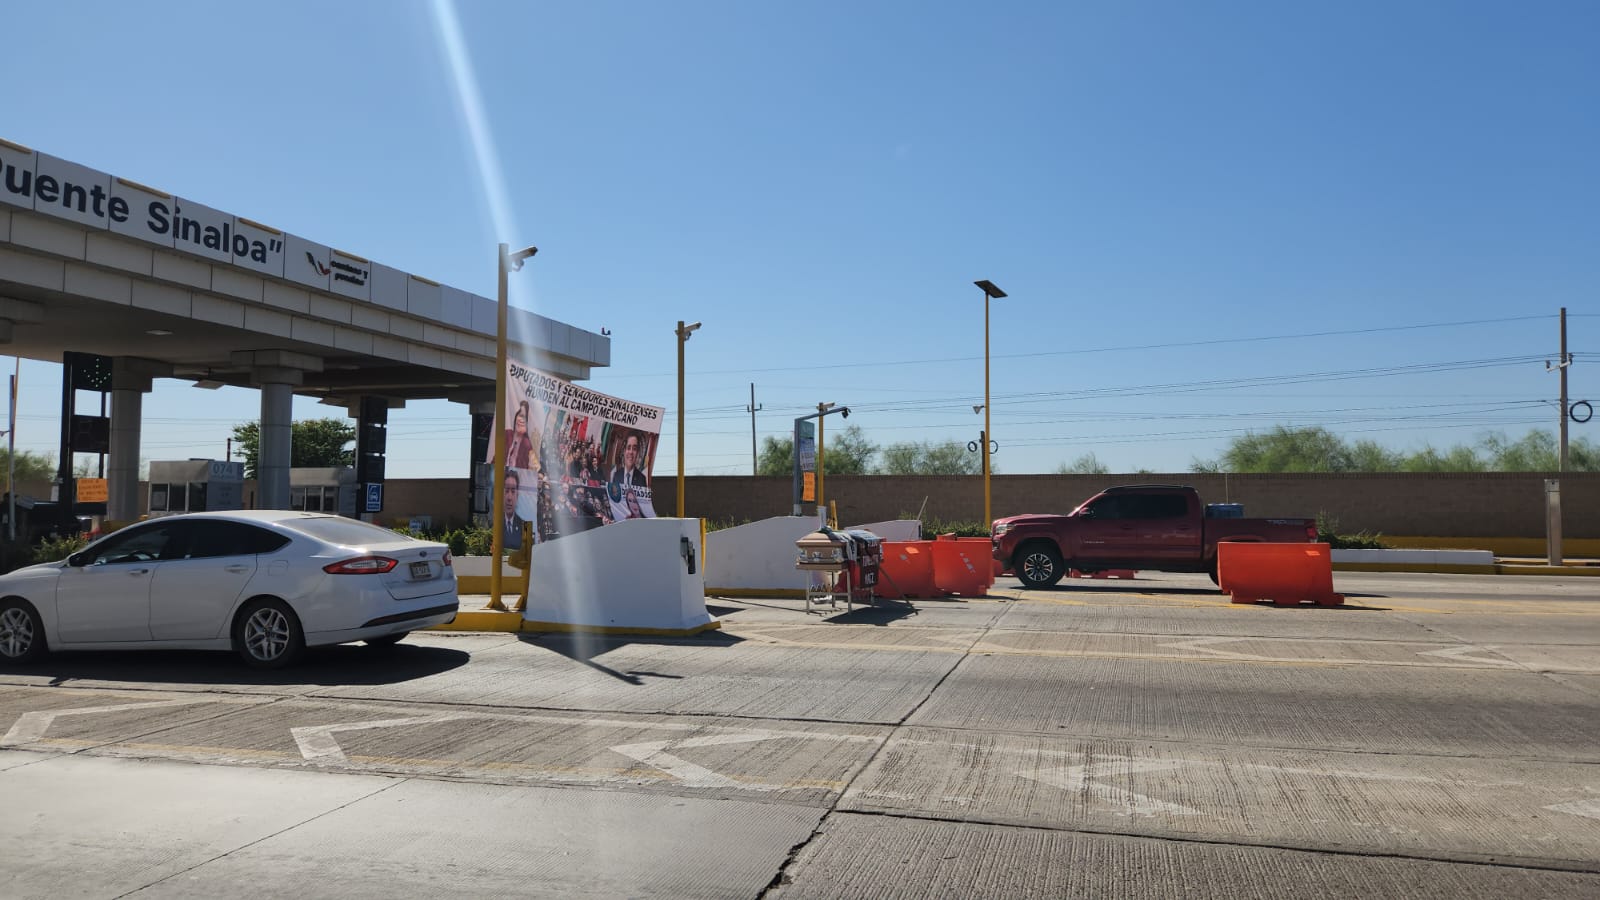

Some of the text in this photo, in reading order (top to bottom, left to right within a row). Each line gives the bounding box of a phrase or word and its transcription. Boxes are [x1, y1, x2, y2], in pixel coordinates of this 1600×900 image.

[0, 157, 282, 264] uente Sinaloa"
[510, 364, 658, 419] DIPUTADOS Y SENADORES SINALOENSES
[525, 385, 638, 425] HUNDEN AL CAMPO MEXICANO
[213, 463, 233, 474] 074
